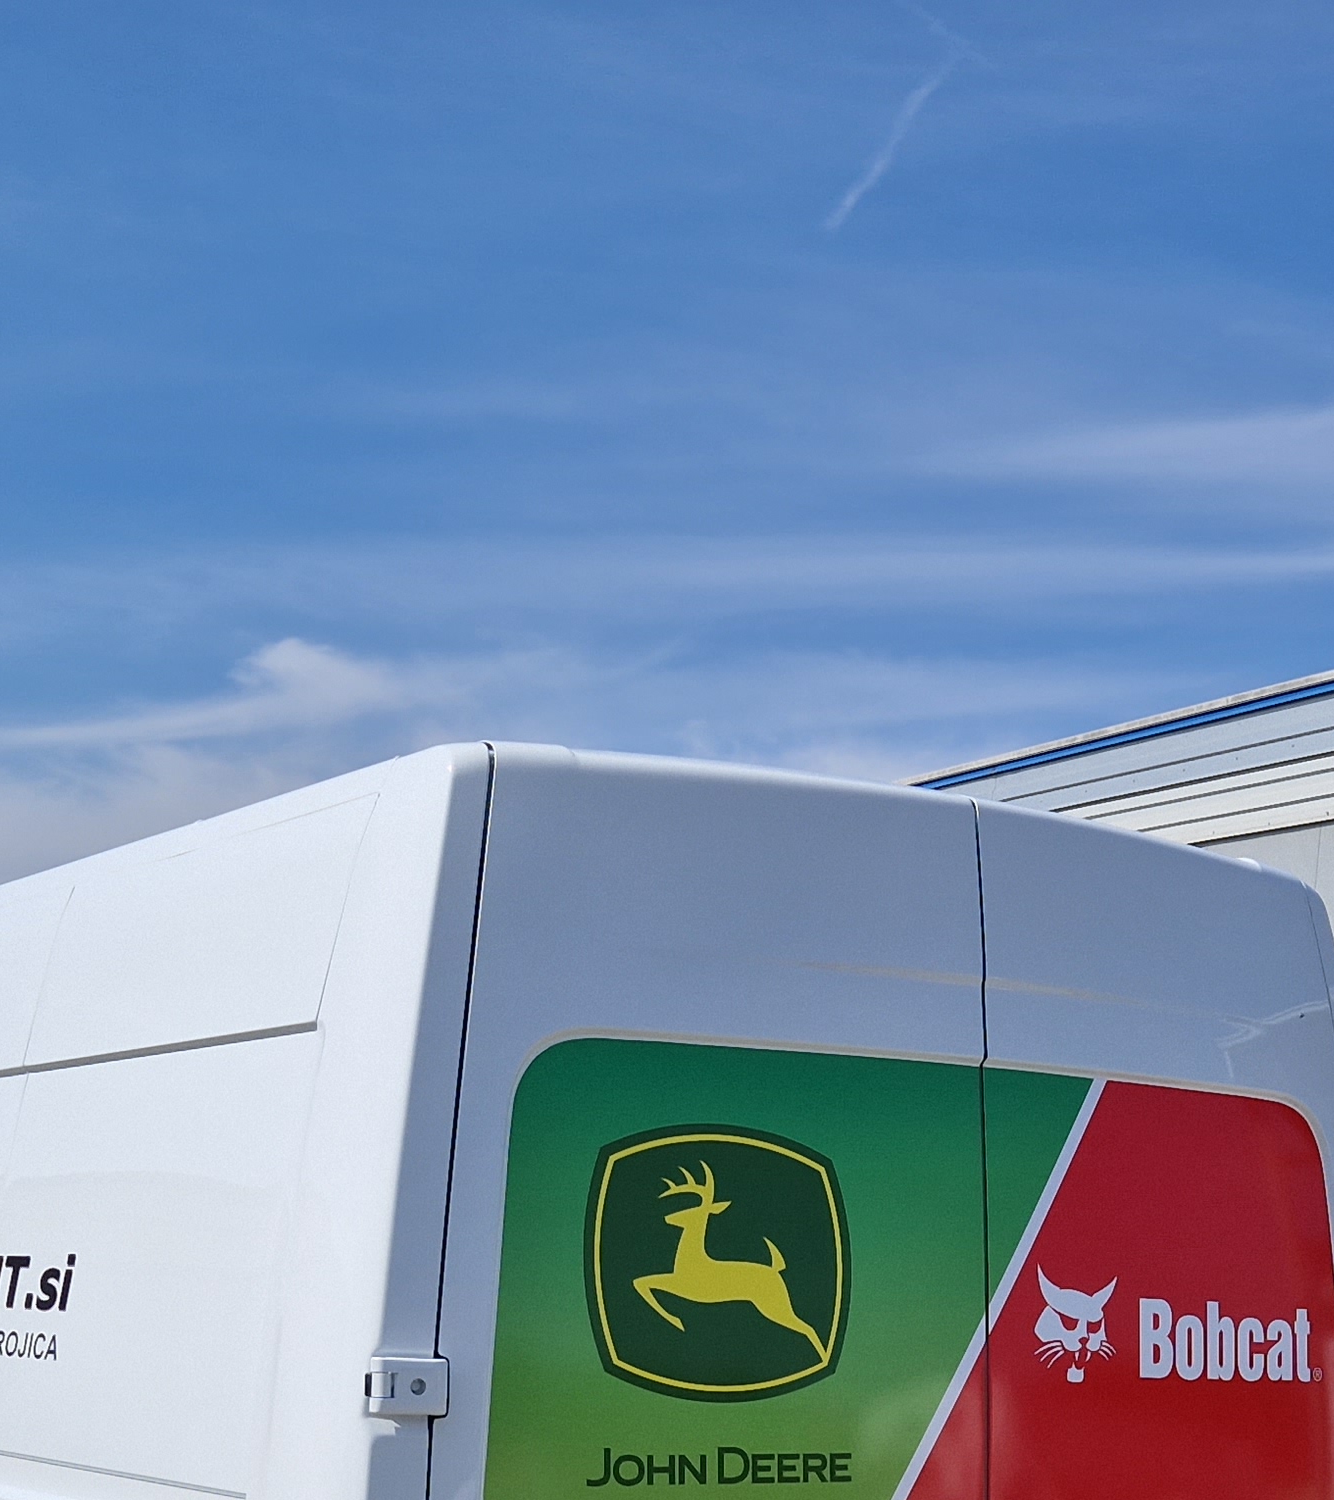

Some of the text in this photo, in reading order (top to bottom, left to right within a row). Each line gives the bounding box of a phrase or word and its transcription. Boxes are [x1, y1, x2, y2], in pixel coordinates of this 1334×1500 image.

[1138, 1297, 1312, 1383] Bobcat
[586, 1446, 852, 1488] JOHN DEERE
